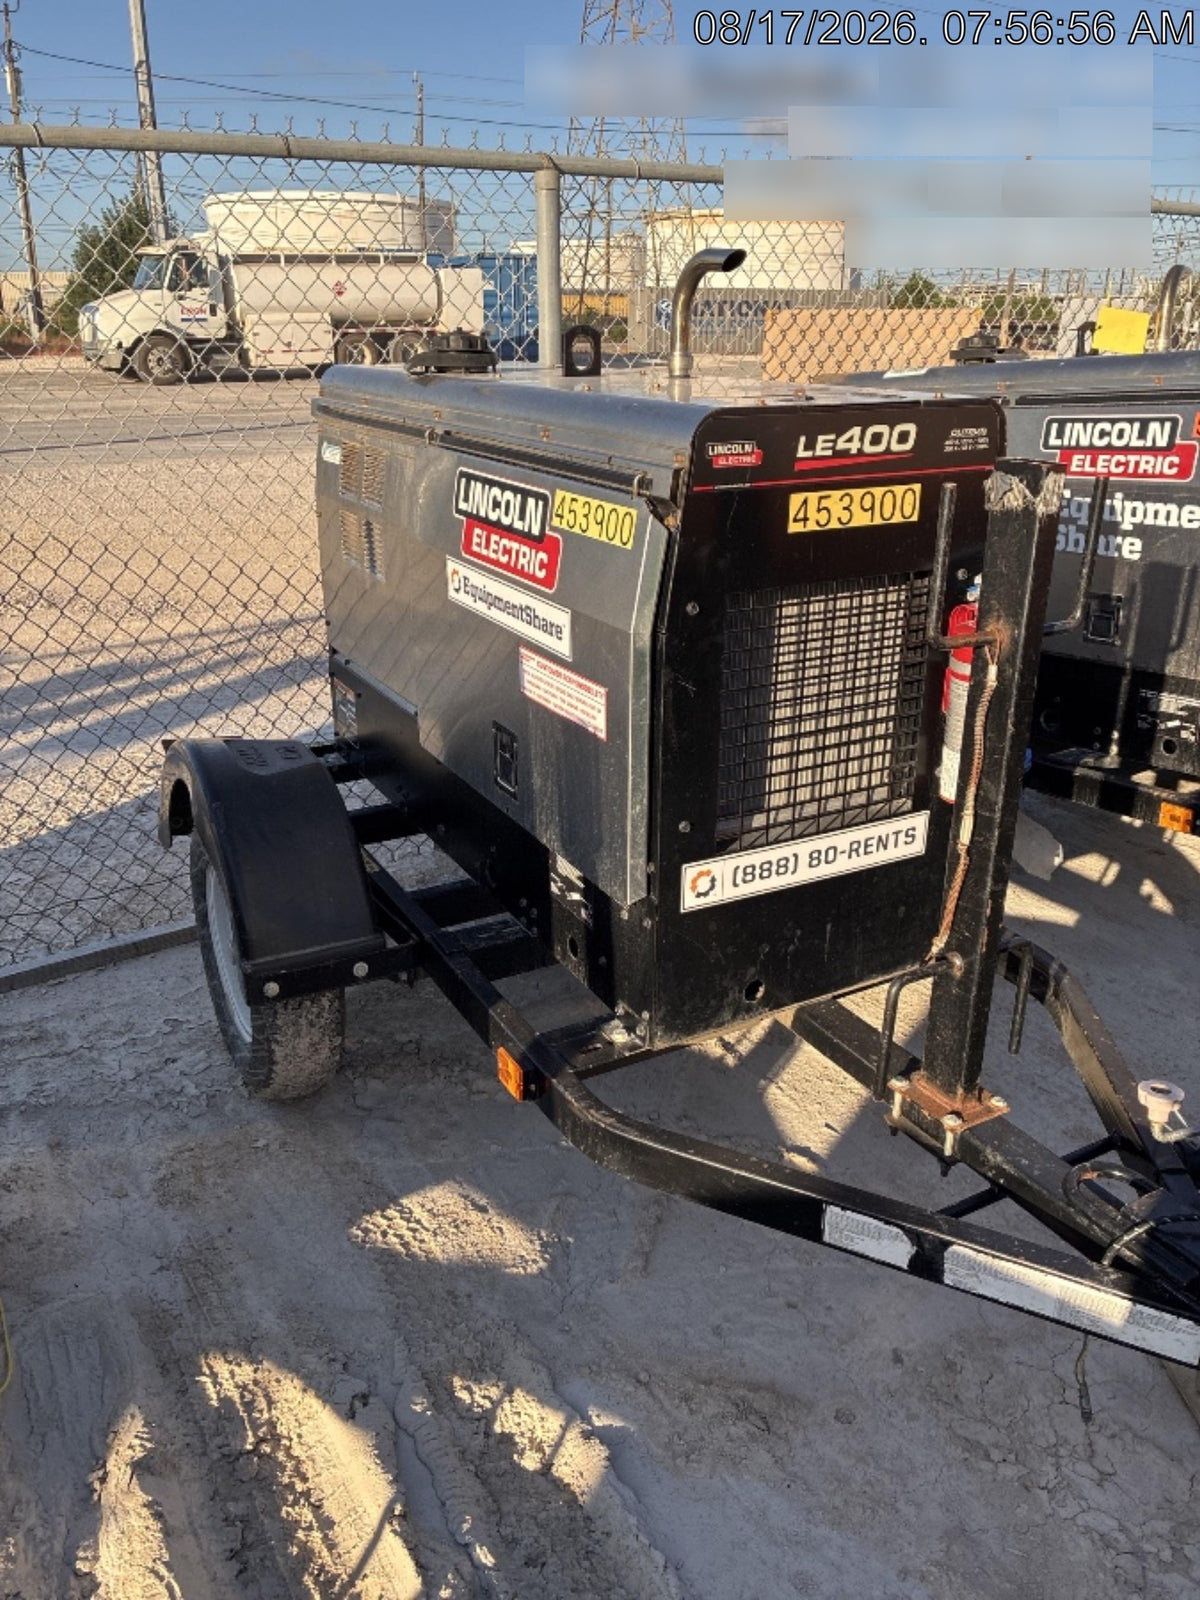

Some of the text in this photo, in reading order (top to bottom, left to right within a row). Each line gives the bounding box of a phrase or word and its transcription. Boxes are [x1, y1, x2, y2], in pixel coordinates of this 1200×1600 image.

[708, 443, 753, 456] LINCOLN
[796, 422, 917, 458] LE400
[1048, 421, 1172, 447] LINCOLN
[1070, 454, 1180, 475] ELECTRIC
[457, 477, 545, 536] LINCOLN
[553, 494, 635, 547] 453900
[792, 487, 917, 529] 453900
[471, 527, 549, 579] ELECTRIC
[463, 575, 563, 641] EquipmentShare
[732, 826, 917, 888] (888) 80-RENTS
